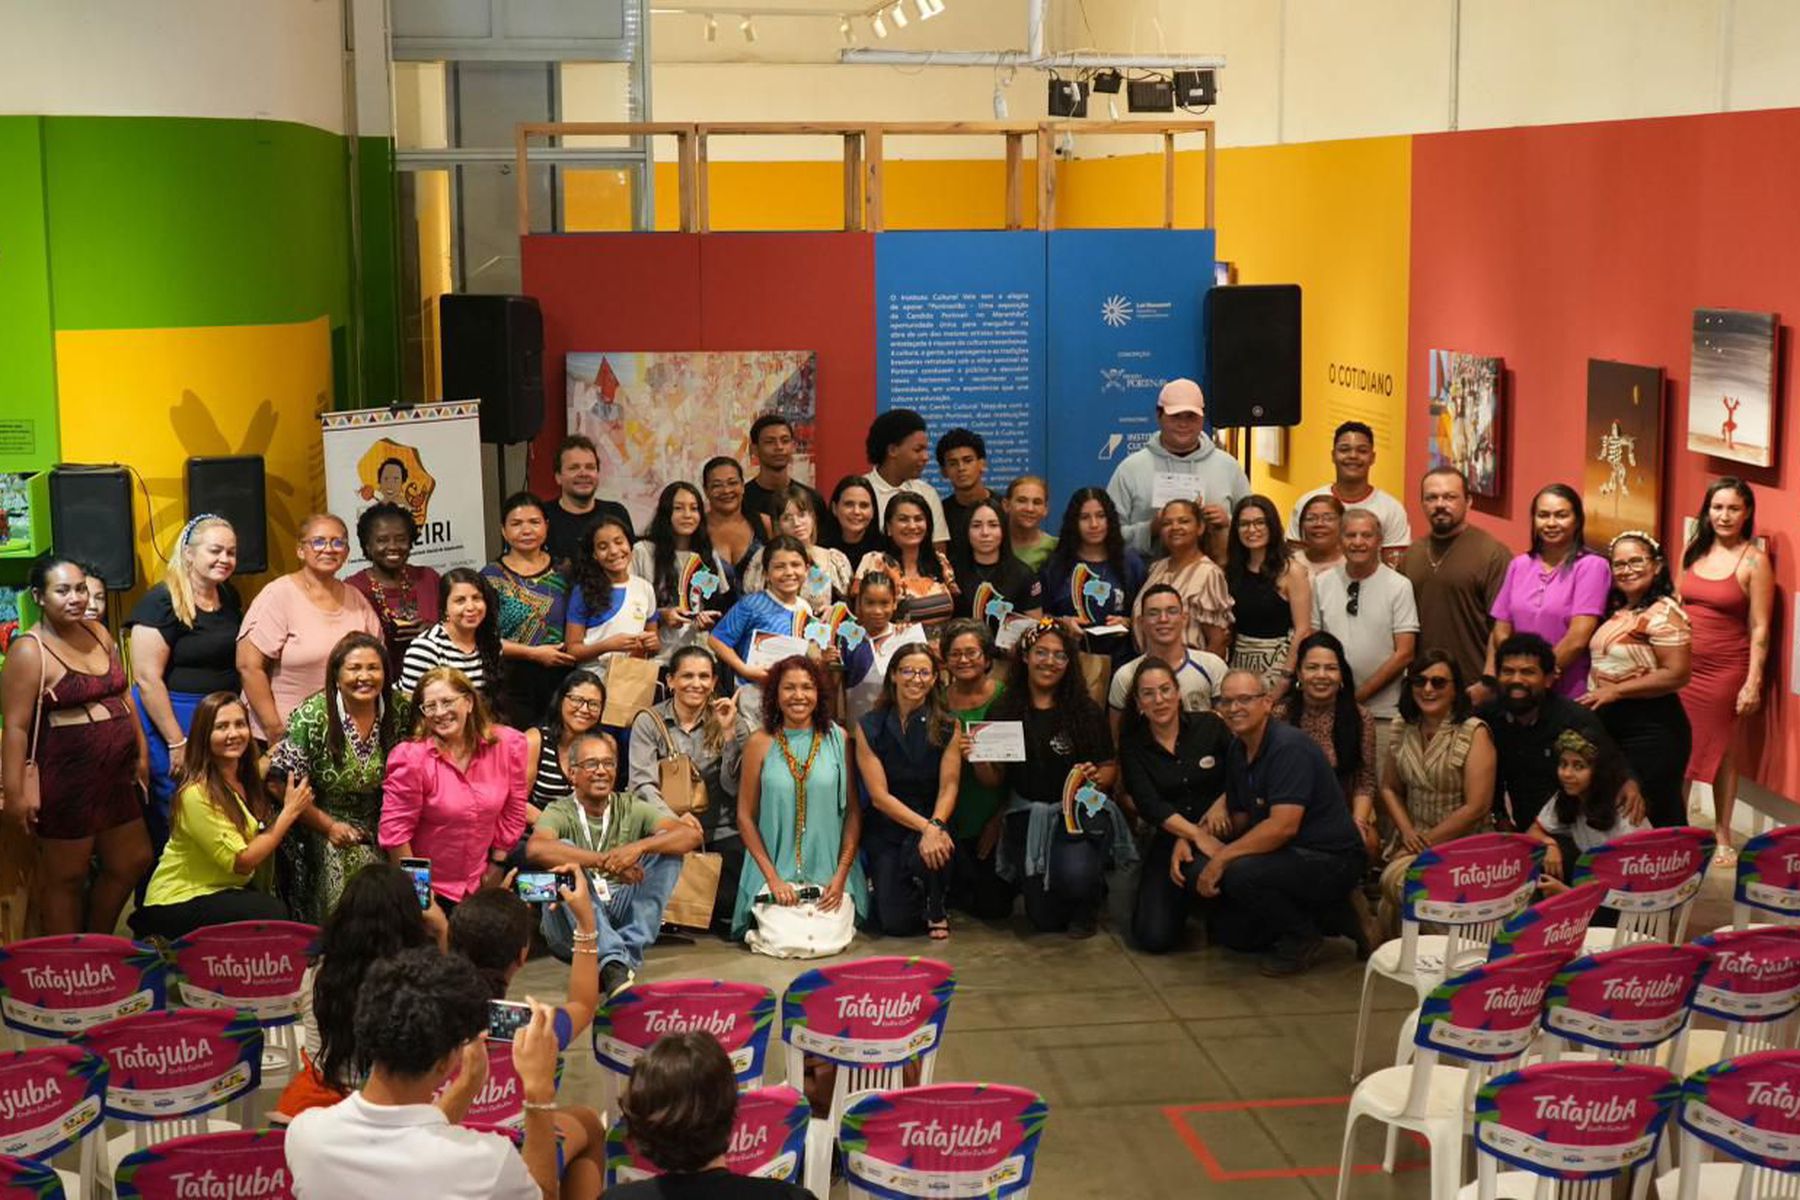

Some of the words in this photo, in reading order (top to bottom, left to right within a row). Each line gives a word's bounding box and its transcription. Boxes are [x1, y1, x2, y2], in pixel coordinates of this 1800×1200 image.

[1329, 363, 1336, 384] O
[1338, 365, 1393, 397] COTIDIANO
[414, 520, 451, 546] EIRI
